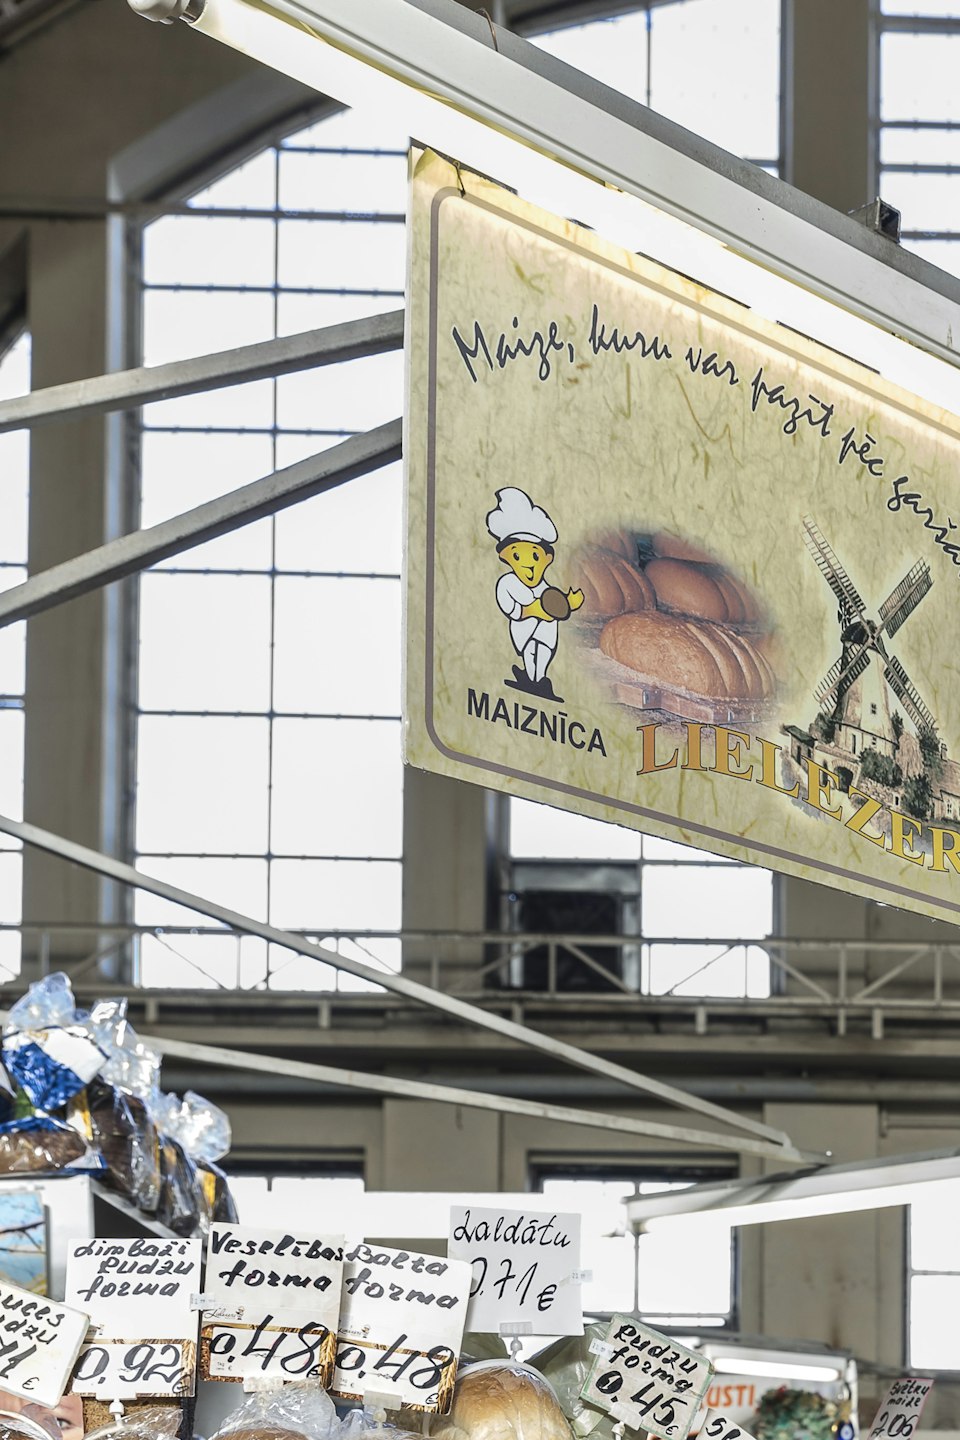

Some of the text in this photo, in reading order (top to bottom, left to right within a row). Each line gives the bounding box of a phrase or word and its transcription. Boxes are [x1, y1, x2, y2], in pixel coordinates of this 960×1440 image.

[452, 316, 573, 383] Maize,
[589, 304, 672, 359] kuru
[686, 347, 739, 385] var
[751, 368, 834, 436] pazīt
[839, 427, 883, 476] pēc
[467, 688, 608, 758] MAIZNĪCA
[698, 1384, 756, 1411] USTI
